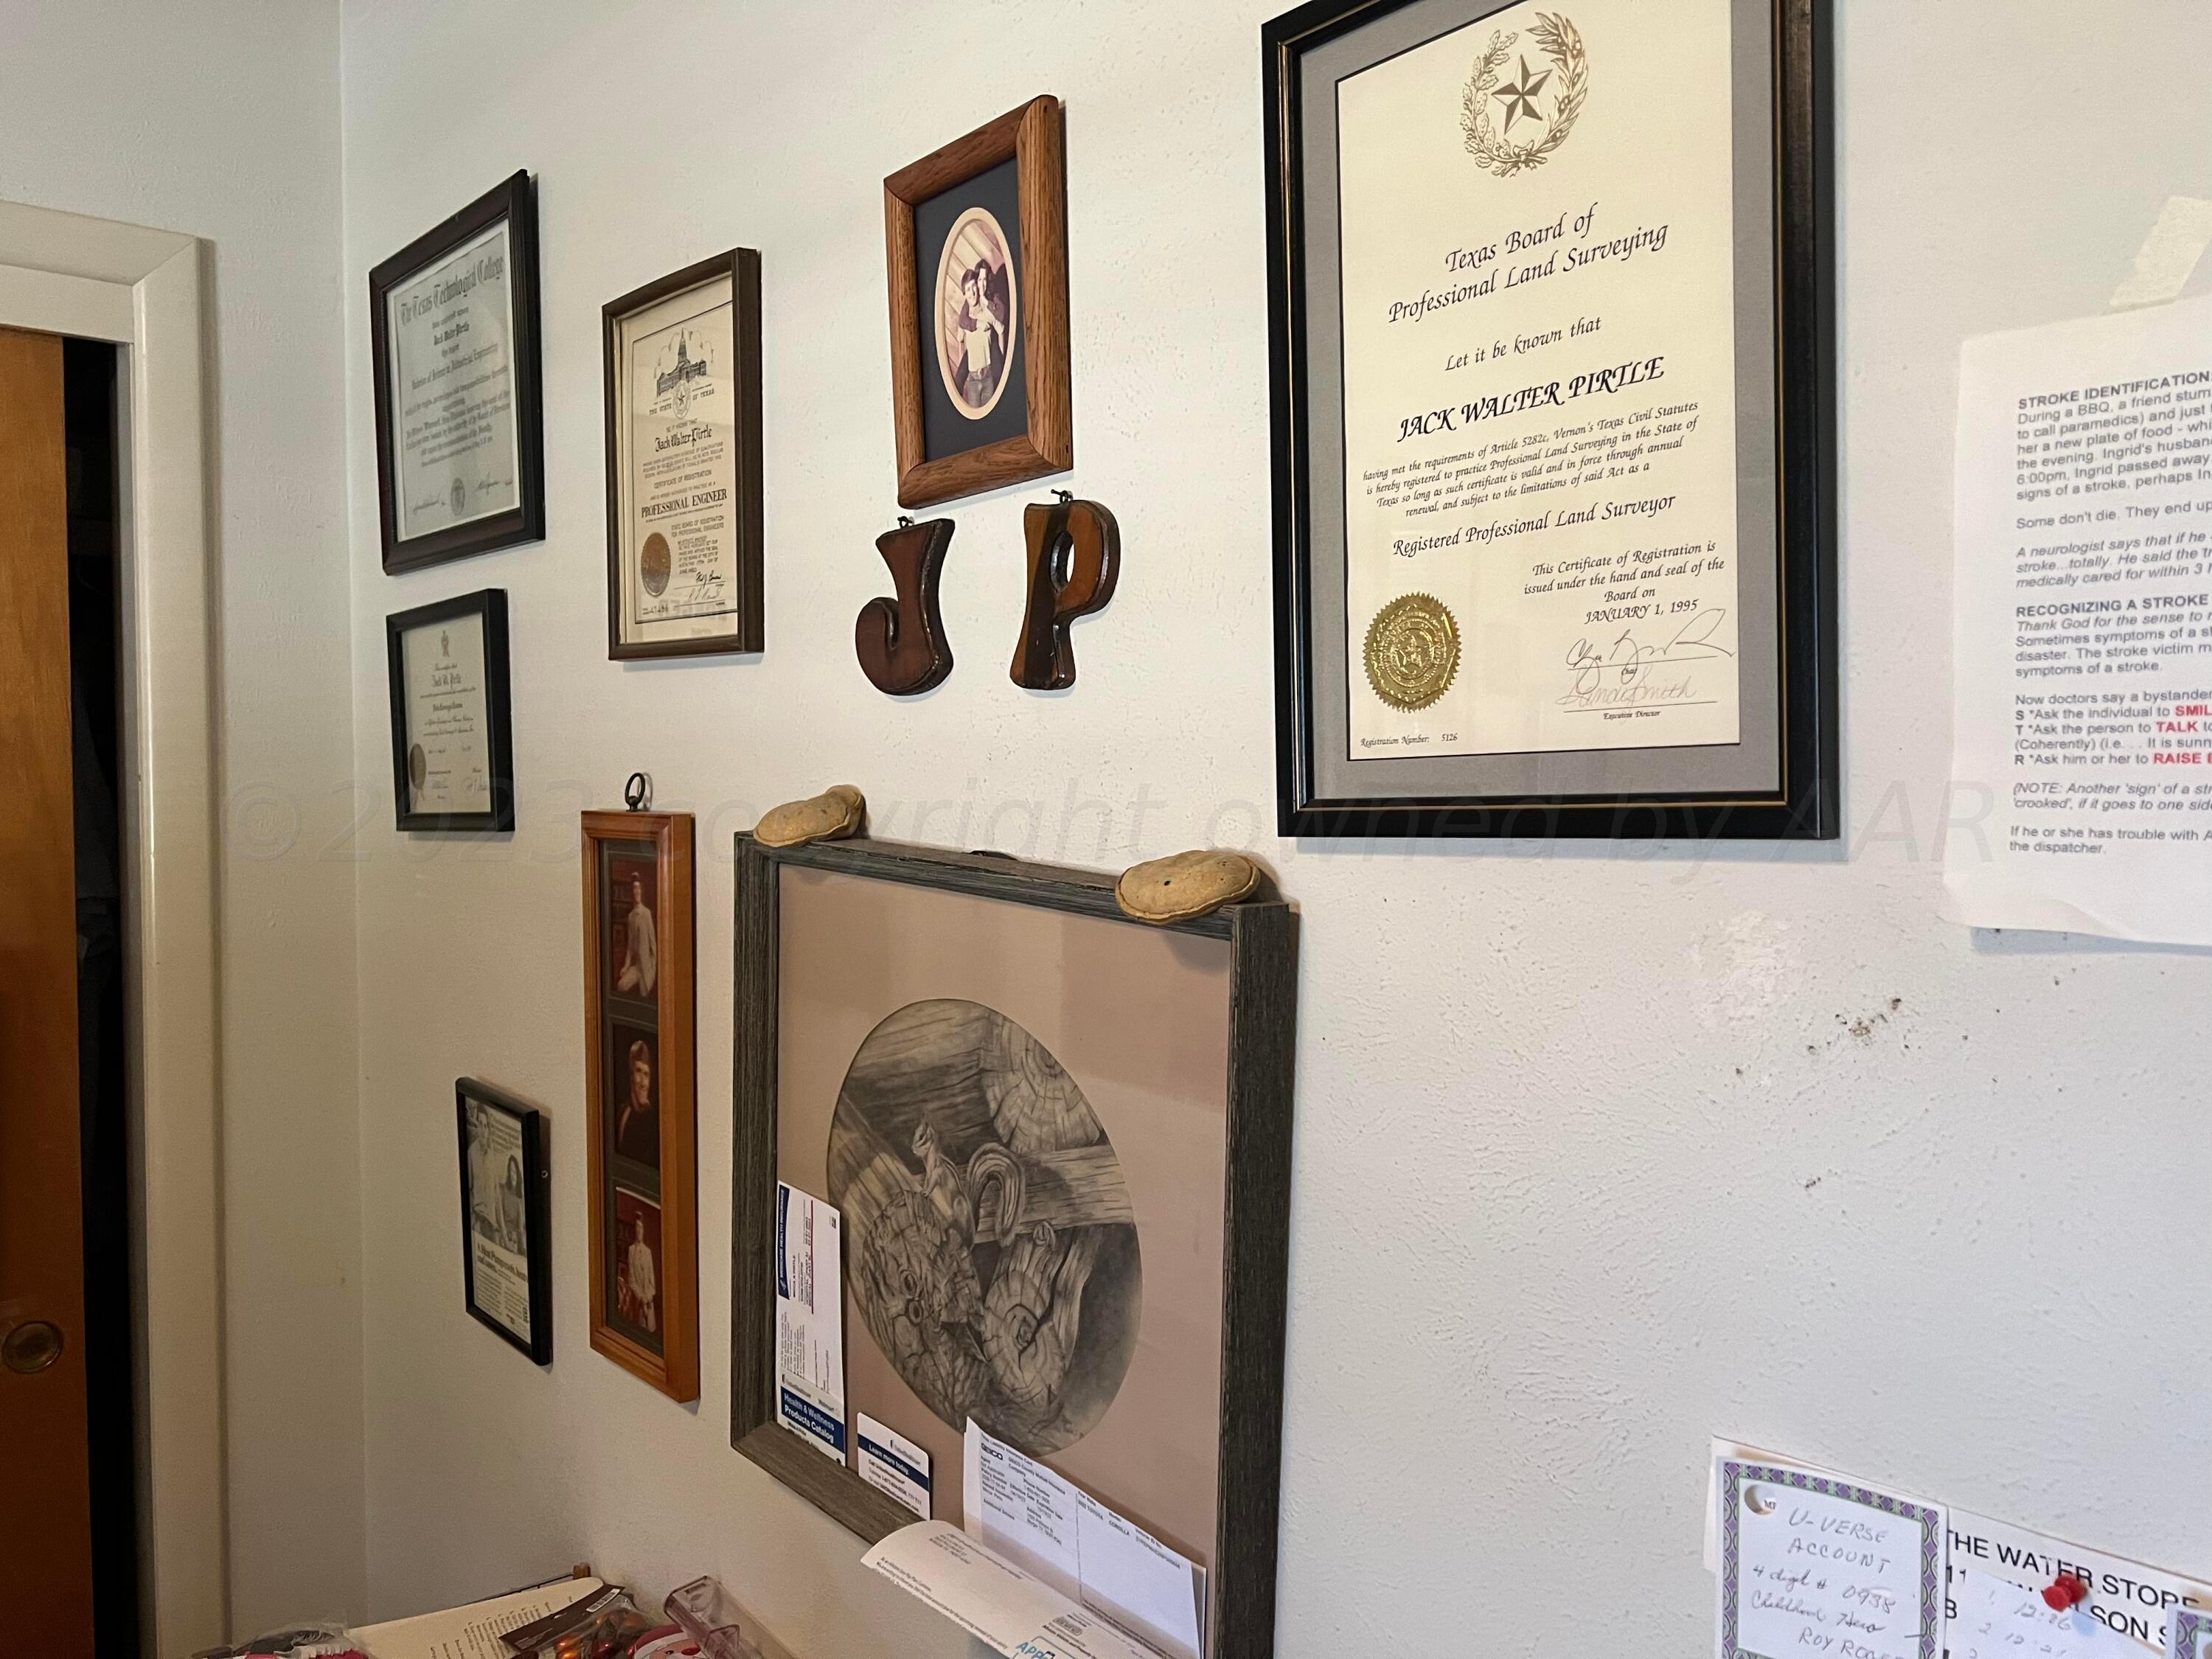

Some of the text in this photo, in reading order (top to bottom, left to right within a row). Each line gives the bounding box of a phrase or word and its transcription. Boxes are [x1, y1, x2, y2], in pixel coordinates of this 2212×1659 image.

[1445, 202, 1598, 272] Texas Board of
[1389, 225, 1668, 323] Professional Land Surveying
[1445, 317, 1601, 371] Let it be known that
[1397, 357, 1665, 442] JACK WALTER PIRTLE
[2018, 411, 2060, 425] During
[2065, 409, 2073, 417] a
[2078, 403, 2112, 416] BBQ,
[2118, 402, 2126, 410] a
[2132, 393, 2171, 408] friend
[2019, 391, 2079, 409] STROKE
[1363, 470, 1388, 480] having
[1392, 466, 1405, 475] met
[1409, 460, 1421, 471] the
[1425, 451, 1475, 470] requirements
[1478, 445, 1488, 459] of
[1490, 439, 1517, 454] Article
[1554, 422, 1593, 439] Vernon's
[1597, 418, 1624, 430] Texas
[1629, 410, 1652, 424] Civil
[1655, 403, 1697, 419] Statutes
[2075, 464, 2112, 479] Ingrid
[2118, 457, 2167, 476] passed
[641, 497, 689, 518] PROFESSIONAL
[692, 488, 727, 507] ENGINEER
[1406, 501, 1439, 516] renewal,
[1443, 497, 1458, 509] and
[1461, 490, 1488, 507] subject
[1505, 486, 1517, 498] the
[1520, 479, 1567, 494] limitations
[1571, 472, 1582, 487] of
[1584, 467, 1604, 482] said
[1607, 467, 1624, 478] Act
[1629, 465, 1639, 473] as
[1644, 463, 1649, 471] a
[1394, 496, 1675, 557] Registered Professional Land Surveyor
[2017, 518, 2055, 529] Some
[2059, 512, 2091, 524] don't
[2126, 507, 2160, 518] They
[2165, 502, 2191, 515] end
[1533, 540, 1716, 576] This Certificate of Registration is
[1525, 557, 1724, 594] issued under the hand and seal of the
[1604, 586, 1655, 602] Board on
[2016, 595, 2208, 617] RECOGNIZING A STROKE
[1585, 599, 1698, 625] JANUARY 1, 1995
[2016, 627, 2196, 647] Sometimes symptoms of a
[2016, 666, 2083, 678] symptoms
[2087, 662, 2100, 674] of
[2104, 664, 2112, 673] a
[2016, 695, 2044, 705] Now
[2048, 694, 2098, 704] doctors
[2102, 694, 2125, 705] say
[2130, 693, 2138, 702] a
[1361, 733, 1457, 748] Registration Number: 5126
[2156, 721, 2198, 733] TALK
[2154, 754, 2202, 764] RAISE
[2010, 841, 2029, 851] the
[785, 1405, 834, 1444] Products Catalog
[1789, 1507, 1888, 1543] U-VERSE
[1787, 1537, 1891, 1573] ACCOUNT
[1799, 1627, 1834, 1652] ROY
